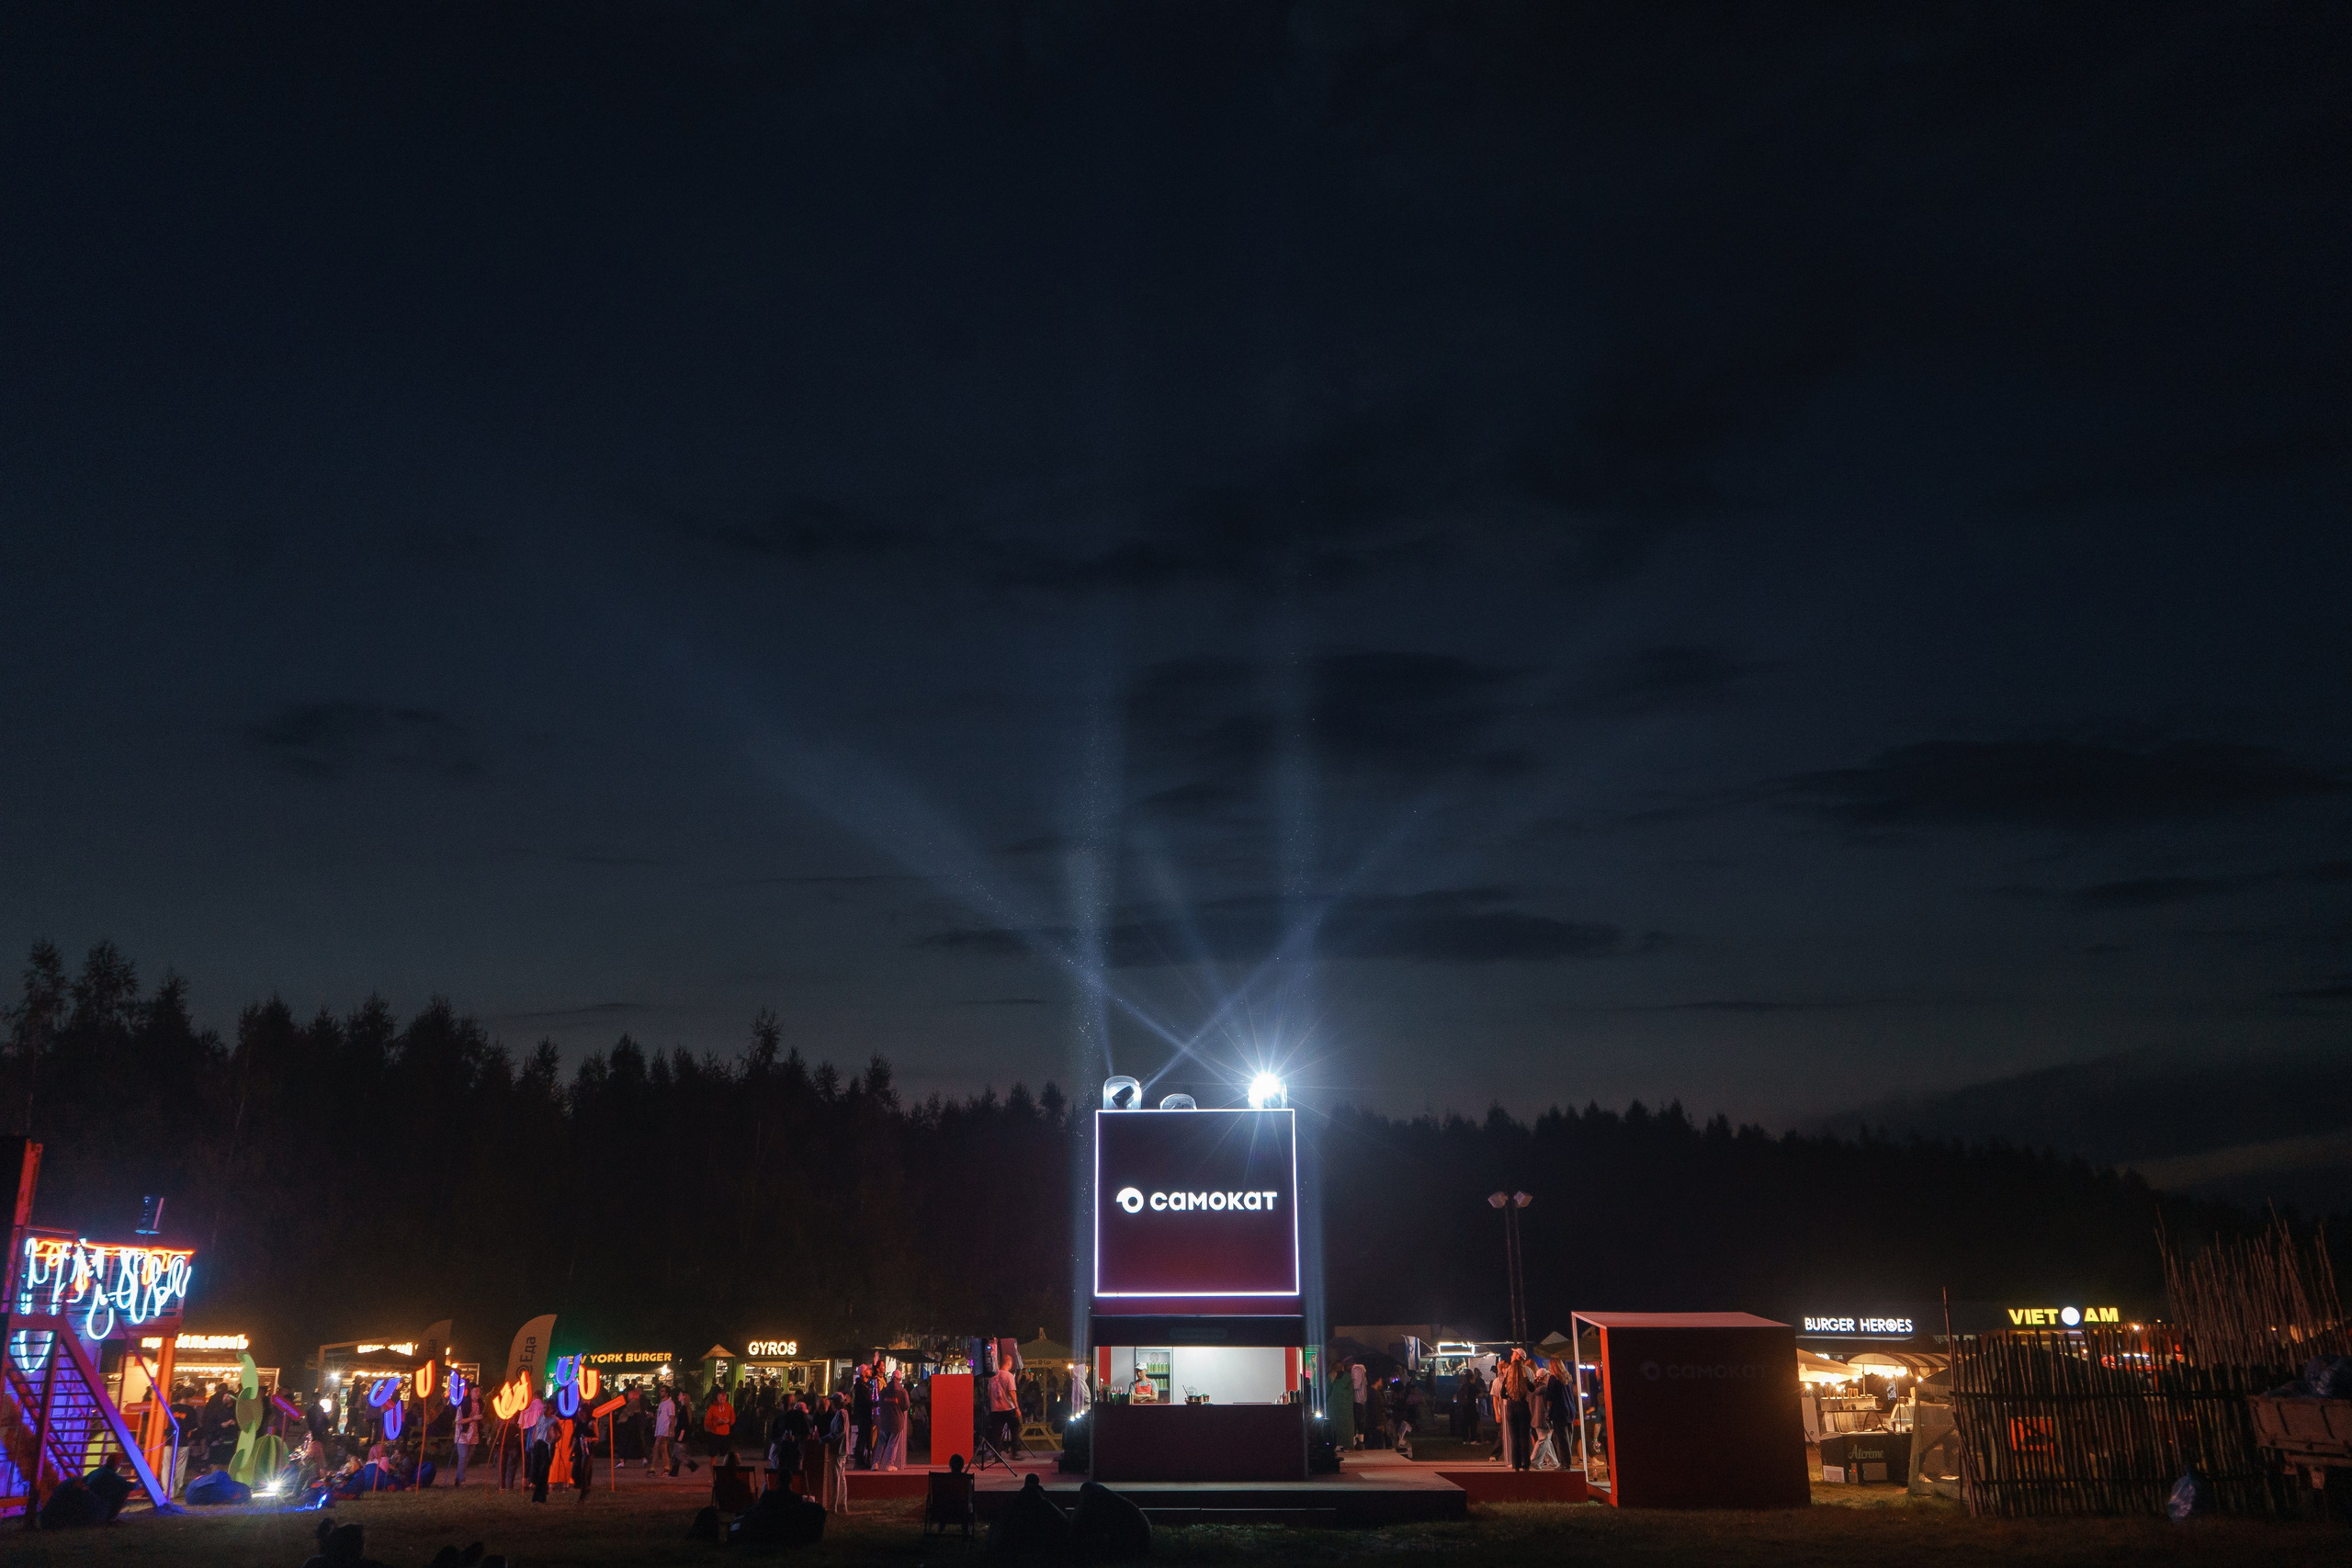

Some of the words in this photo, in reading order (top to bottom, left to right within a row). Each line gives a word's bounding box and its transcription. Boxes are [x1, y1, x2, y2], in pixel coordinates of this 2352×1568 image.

[1804, 1317, 1855, 1332] BURGER
[1860, 1318, 1913, 1333] HEROES
[519, 1337, 537, 1362] Еда
[748, 1341, 797, 1356] GYROS
[590, 1353, 624, 1364] YORK
[626, 1352, 672, 1362] BURGER
